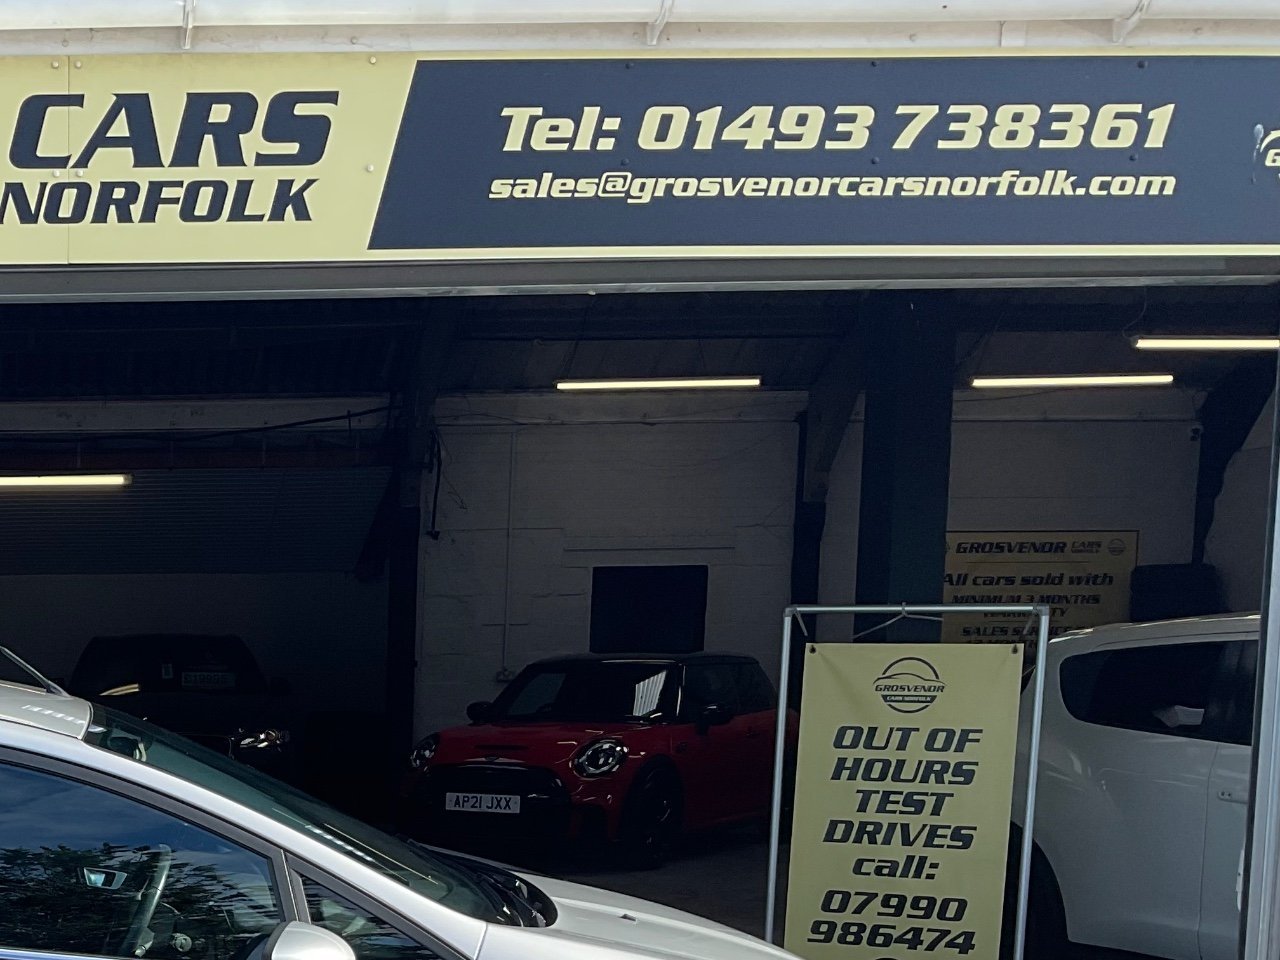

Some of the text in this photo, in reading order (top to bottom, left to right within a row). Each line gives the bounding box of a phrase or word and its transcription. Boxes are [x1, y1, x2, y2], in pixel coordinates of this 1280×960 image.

[9, 91, 339, 169] CARS
[501, 104, 1175, 151] Tel: 01493 738361
[489, 170, 1176, 203] sales@grosvenorcarsnorfolk.com
[956, 541, 1067, 554] GROSVENOR
[943, 573, 1114, 586] All cars sold with
[1038, 594, 1101, 604] MONTHS
[961, 626, 1009, 636] SALES
[875, 684, 945, 693] GROSVENOR
[833, 726, 983, 753] OUT OF
[830, 757, 978, 785] HOURS
[453, 794, 512, 810] AP21 JXX
[856, 789, 954, 817] TEST
[823, 820, 977, 850] DRIVES
[852, 855, 939, 880] call:
[821, 890, 967, 921] 07990
[807, 920, 976, 955] 986474
